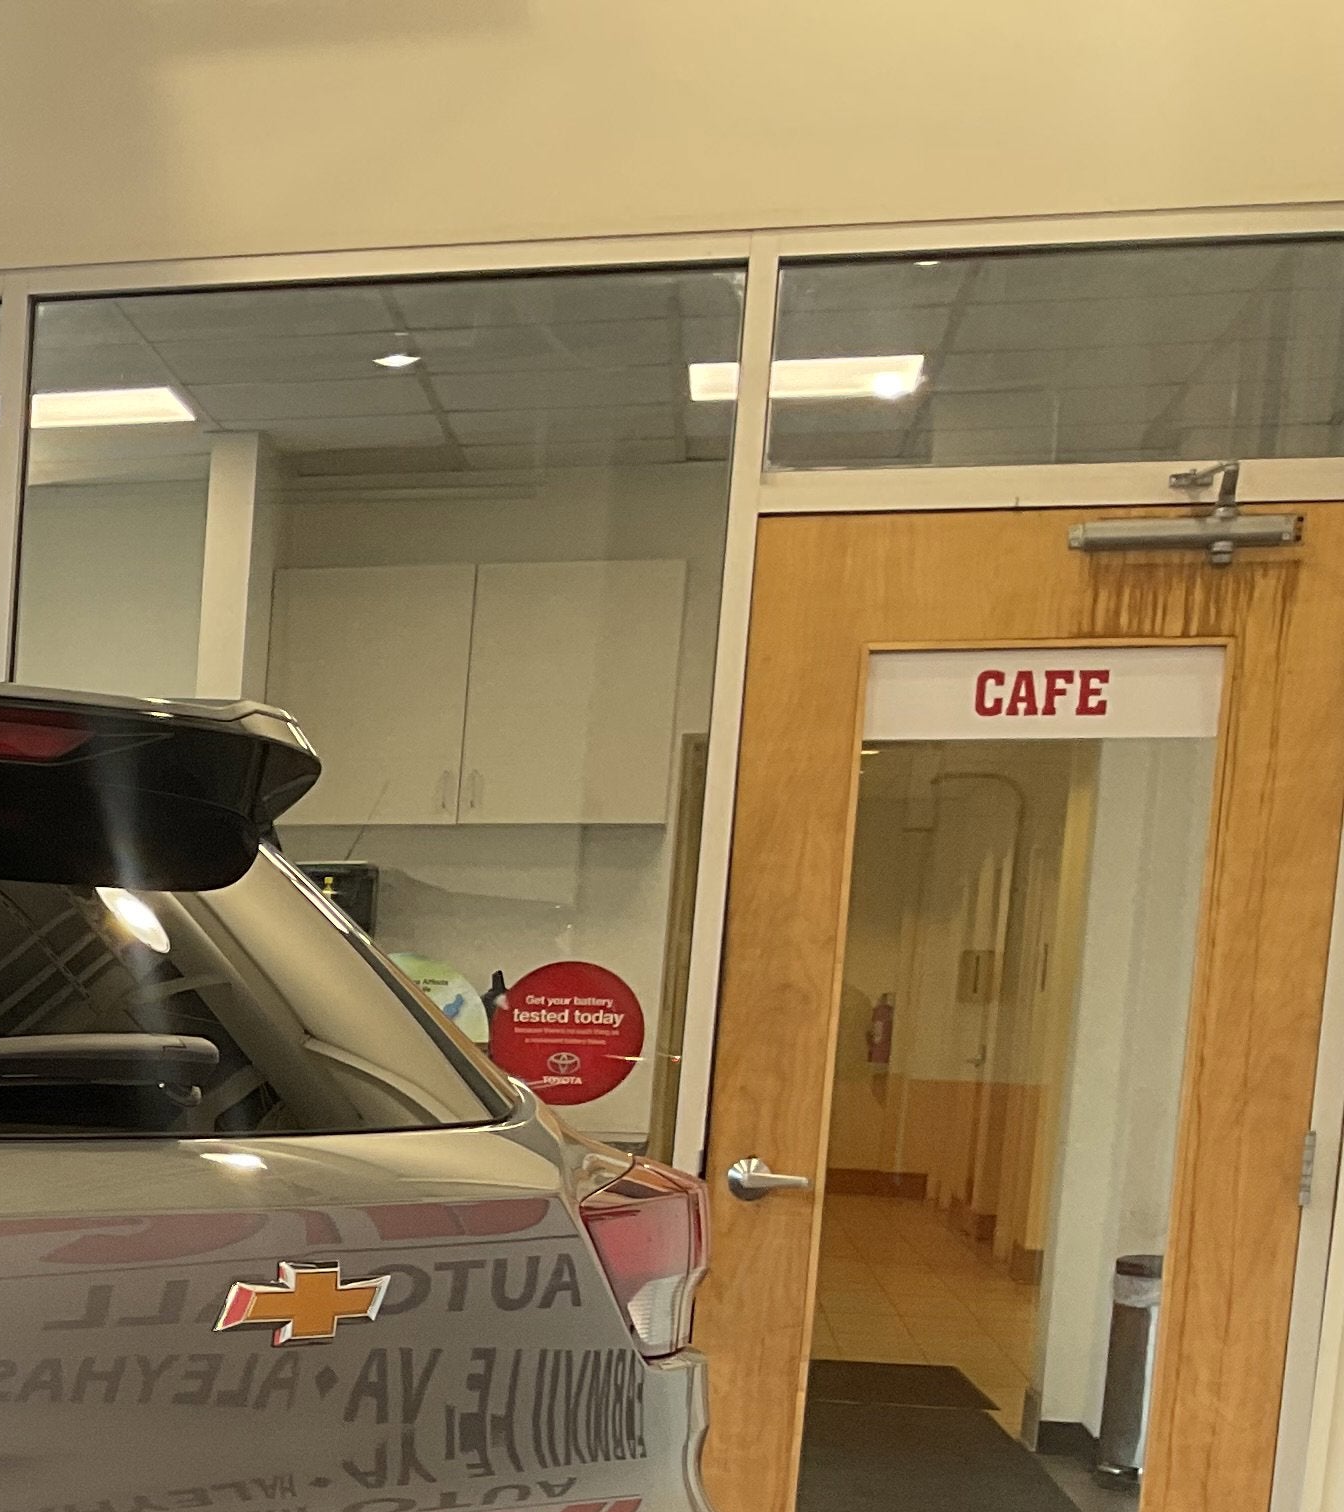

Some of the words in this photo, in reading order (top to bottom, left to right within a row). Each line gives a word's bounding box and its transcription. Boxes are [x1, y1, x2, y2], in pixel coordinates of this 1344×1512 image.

[974, 669, 1110, 717] CAFE
[525, 995, 545, 1005] Get
[547, 997, 572, 1007] your
[573, 996, 614, 1008] battery
[513, 1008, 570, 1023] tested
[574, 1009, 625, 1028] today
